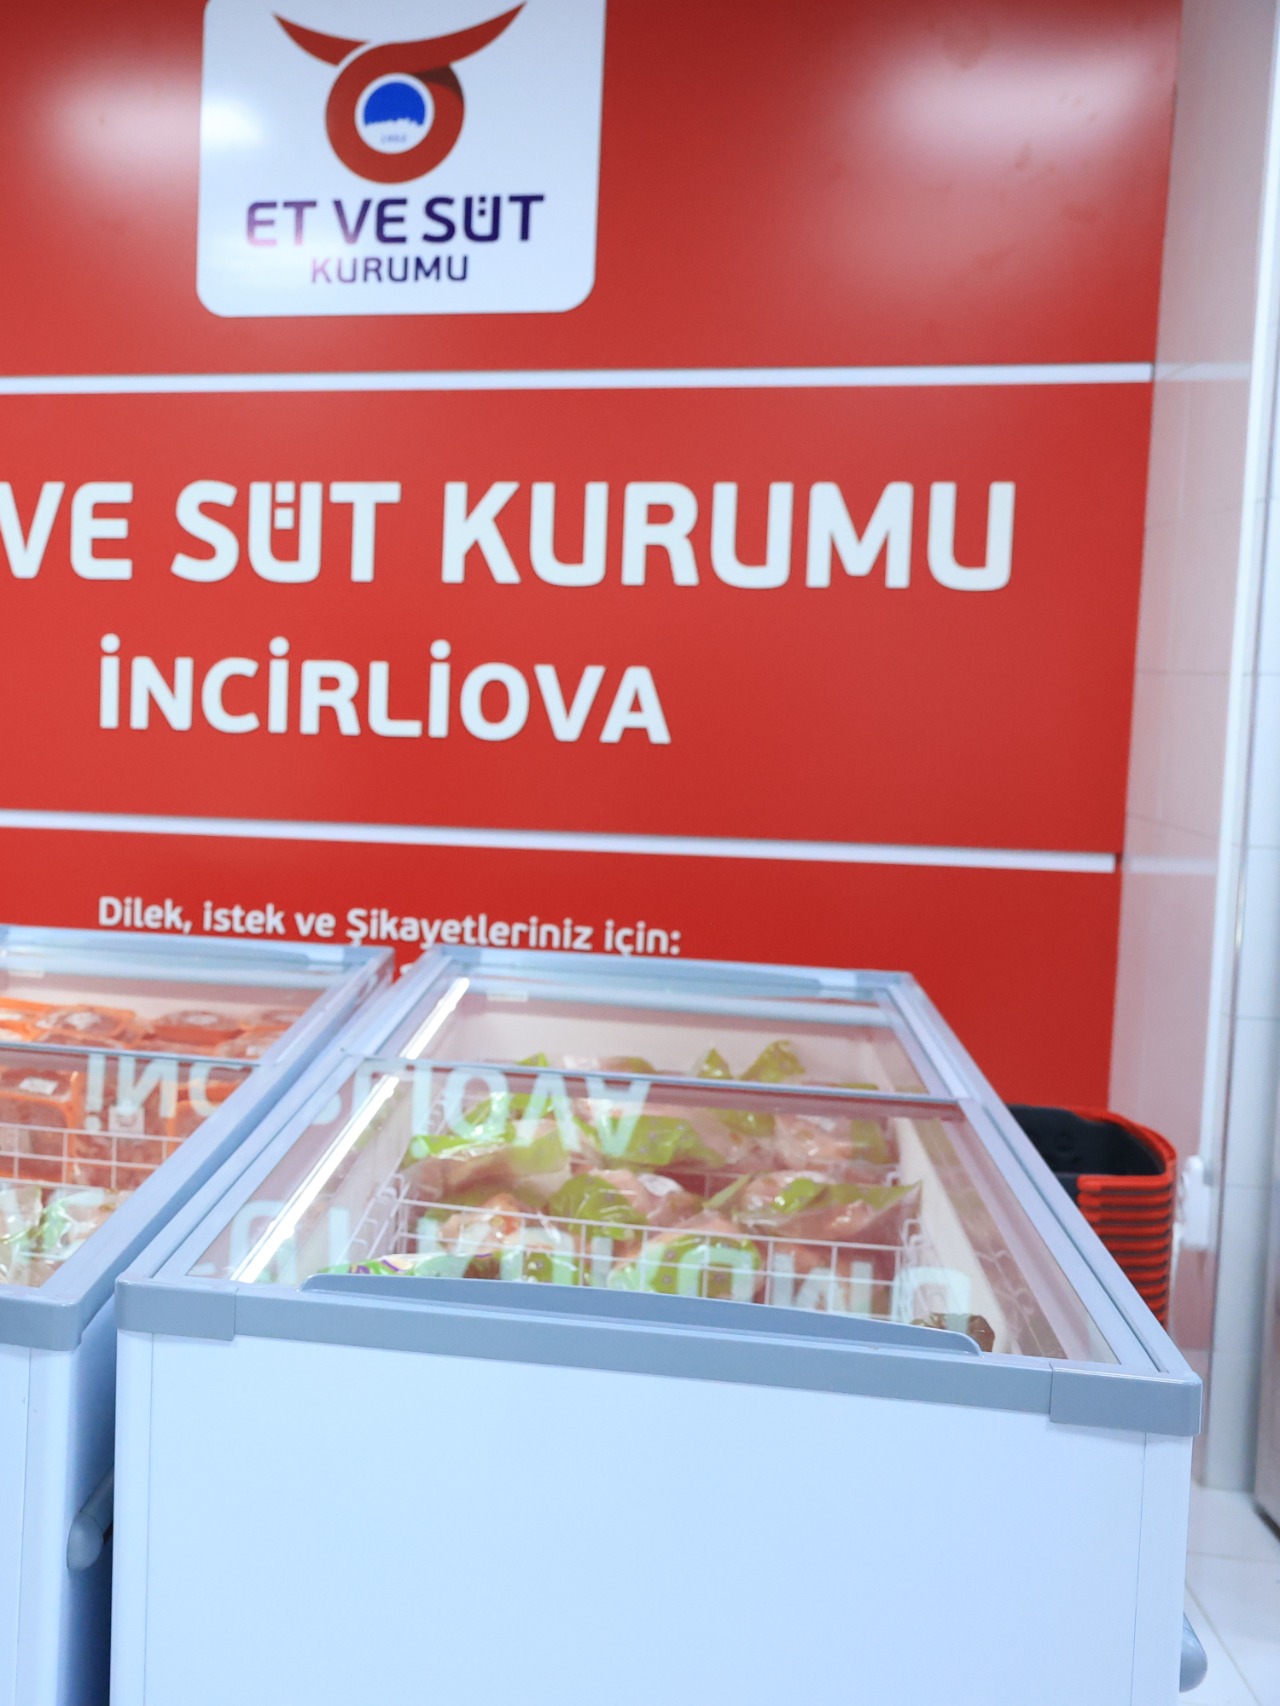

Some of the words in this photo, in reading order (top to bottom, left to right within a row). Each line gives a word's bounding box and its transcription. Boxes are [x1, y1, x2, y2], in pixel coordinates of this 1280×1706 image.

[246, 201, 317, 247] ET
[333, 198, 409, 245] VE
[422, 195, 545, 243] SÜT
[311, 256, 469, 284] KURUMU
[170, 479, 402, 584] SÜT
[441, 480, 1016, 592] KURUMU
[99, 633, 671, 745] İNCİRLİOVA
[99, 896, 192, 935] Dilek,
[203, 901, 285, 935] istek
[295, 912, 336, 937] ve
[346, 907, 593, 950] Şikayetleriniz
[604, 919, 682, 956] için:
